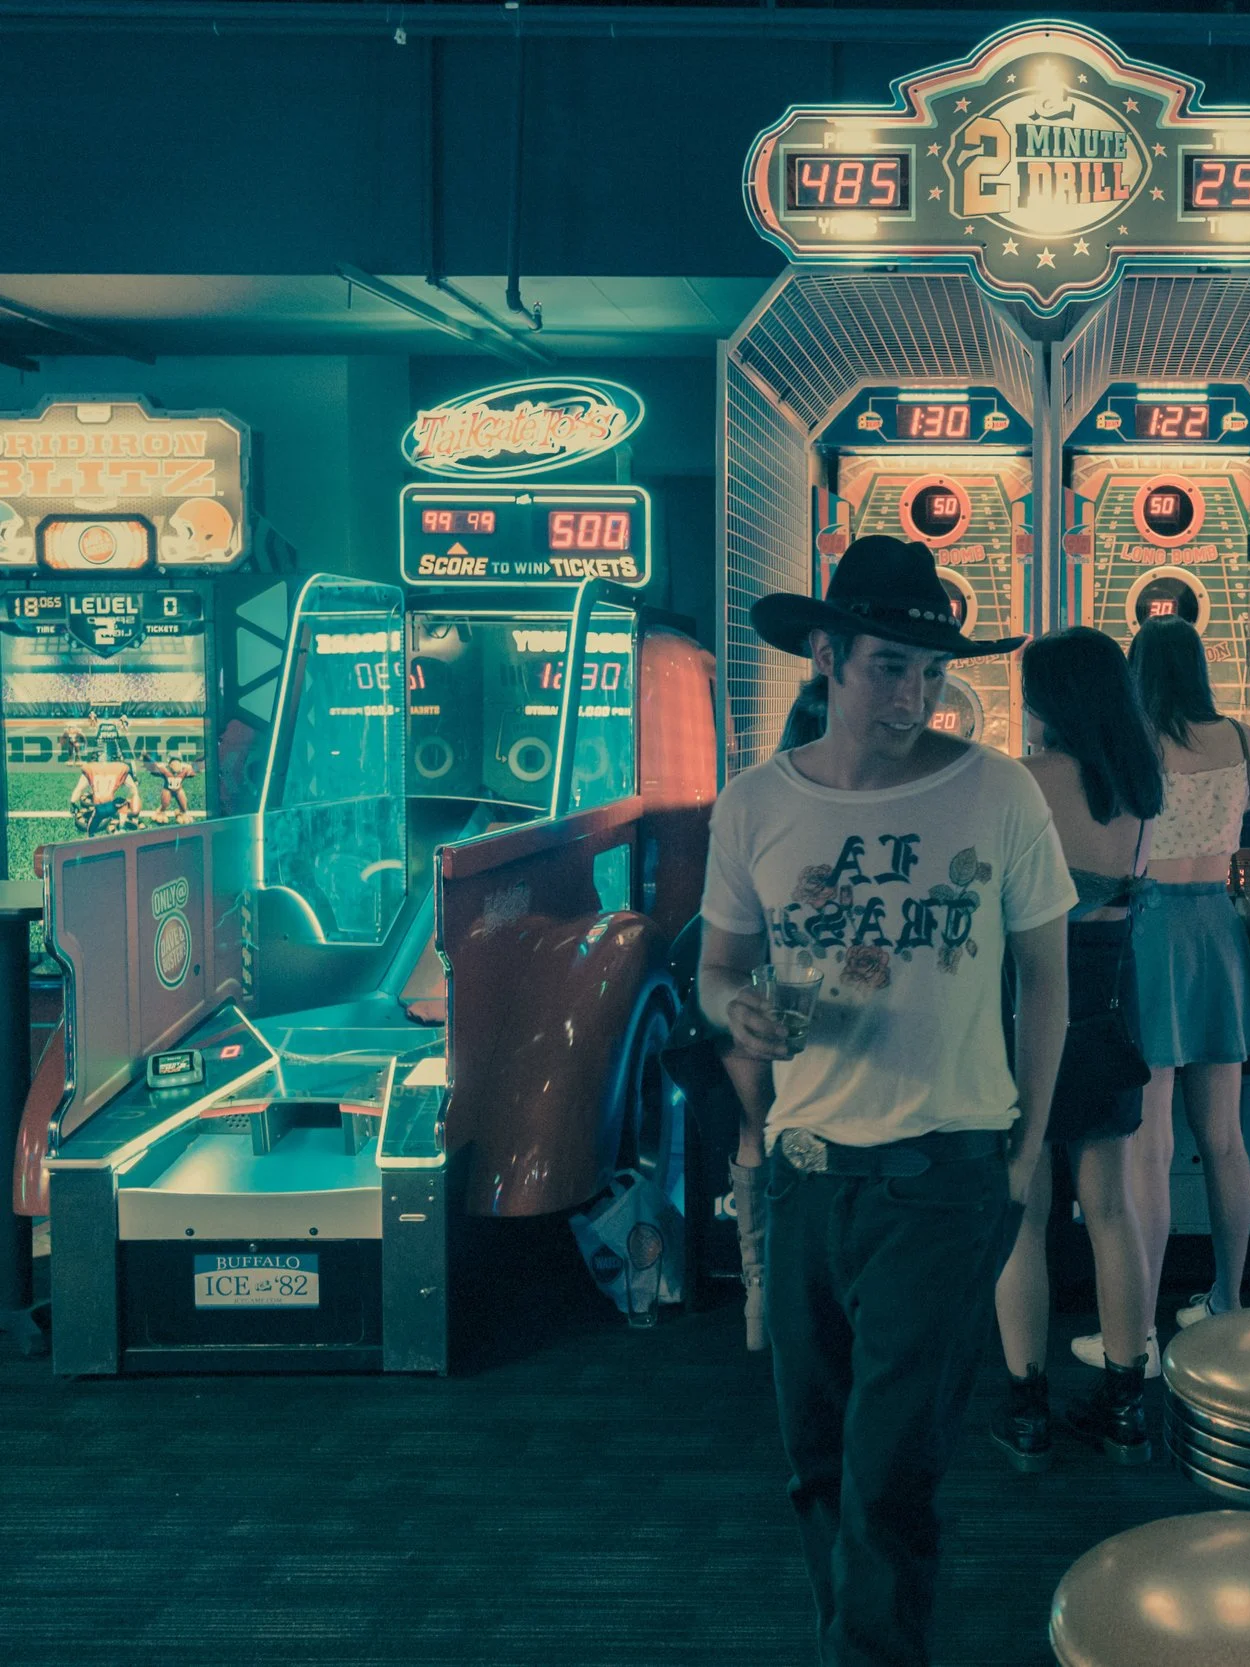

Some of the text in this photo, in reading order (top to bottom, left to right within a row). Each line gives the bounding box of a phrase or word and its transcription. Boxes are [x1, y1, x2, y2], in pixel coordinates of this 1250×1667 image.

[1015, 123, 1128, 159] MINUTE
[801, 162, 897, 205] 485
[1017, 161, 1130, 205] DRILL
[909, 406, 969, 437] 1:30
[1149, 406, 1208, 437] 1:22
[0, 432, 208, 458] RIDIRON
[933, 497, 957, 516] 50
[1150, 497, 1175, 515] 50
[550, 514, 628, 549] 500
[937, 545, 986, 566] BOMB
[1120, 543, 1219, 565] LONG BOMB
[418, 554, 637, 578] SCORE TO WIN TICKETS
[1150, 602, 1173, 616] 30
[36, 624, 55, 634] TIME
[146, 624, 179, 633] TICKETS
[932, 713, 956, 729] 20
[216, 1256, 301, 1270] BUFFALO
[205, 1275, 308, 1296] ICE '82
